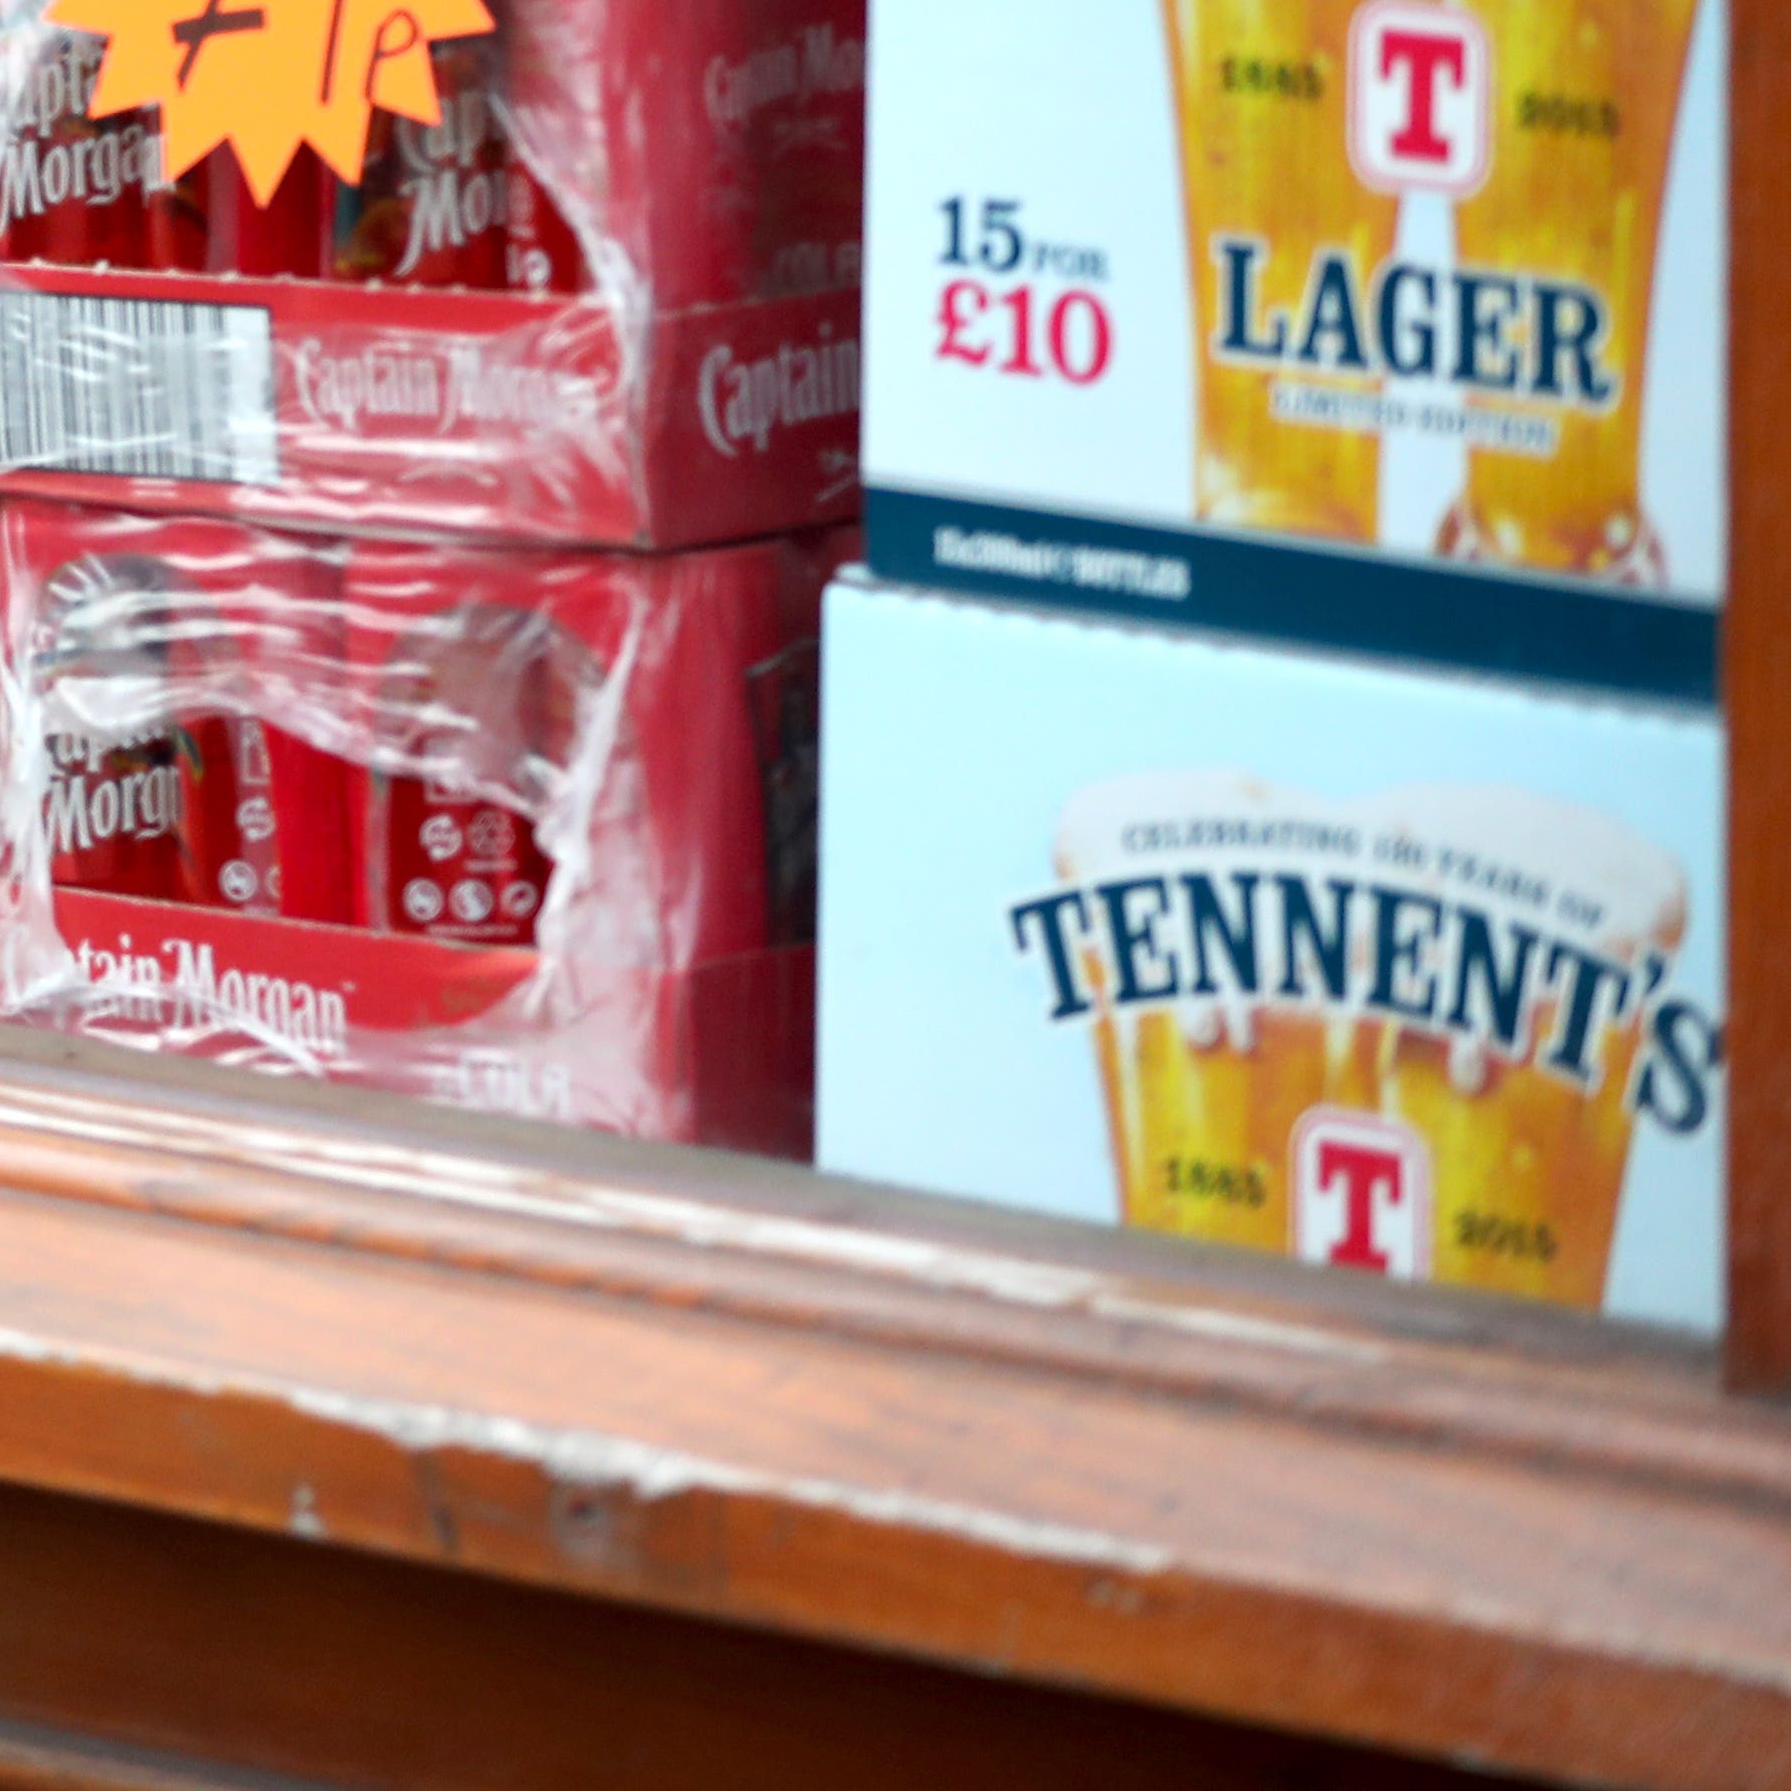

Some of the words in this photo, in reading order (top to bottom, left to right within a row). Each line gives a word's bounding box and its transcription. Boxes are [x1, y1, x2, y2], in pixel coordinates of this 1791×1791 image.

[1378, 25, 1466, 167] T
[935, 195, 1024, 275] 15
[934, 277, 1115, 387] £10
[1217, 241, 1616, 408] LAGER
[1006, 869, 1725, 1138] TENNENT'S
[1316, 1137, 1407, 1275] T
